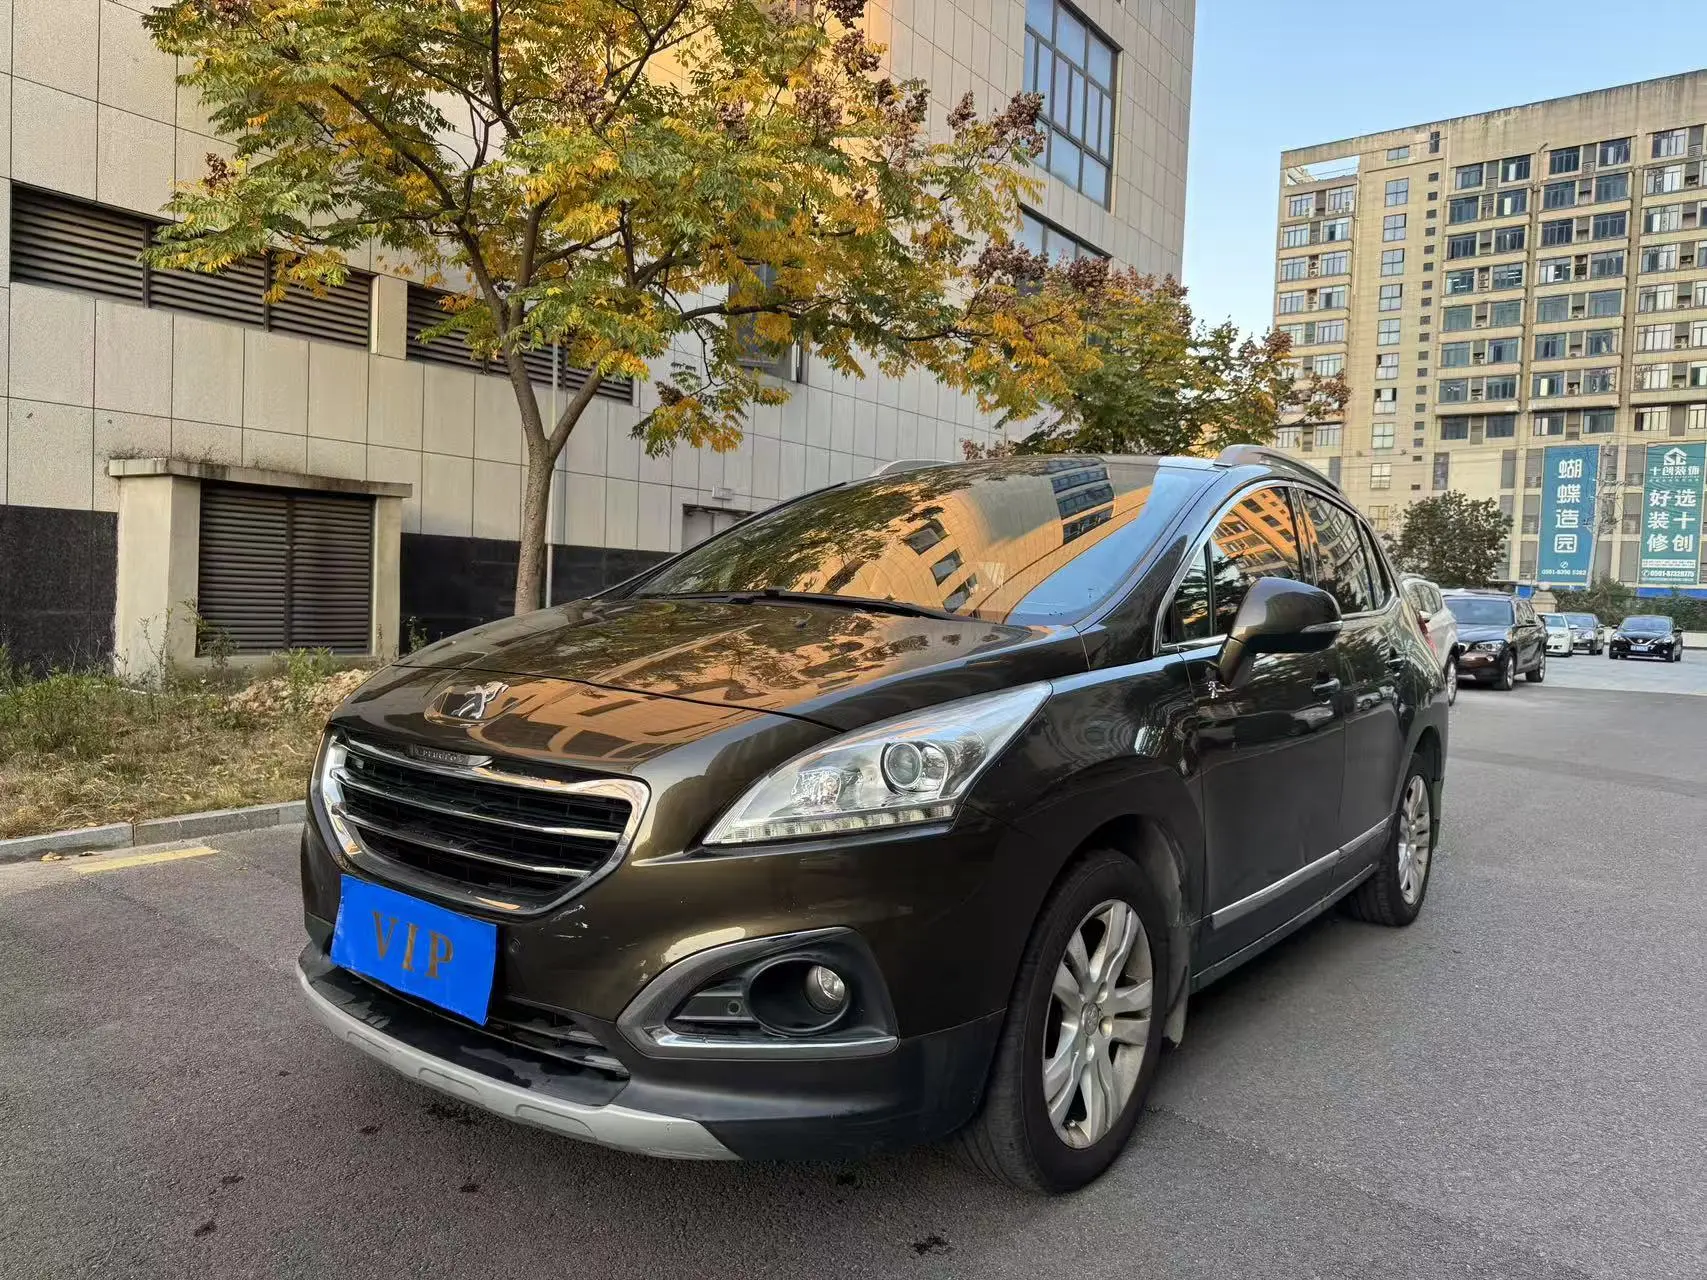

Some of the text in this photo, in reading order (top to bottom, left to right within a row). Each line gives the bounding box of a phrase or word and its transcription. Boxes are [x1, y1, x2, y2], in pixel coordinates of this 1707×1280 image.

[1554, 458, 1583, 554] 蝴蝶造园
[1647, 489, 1672, 553] 好装修
[1672, 488, 1697, 553] 选十创
[372, 911, 454, 979] VIP
